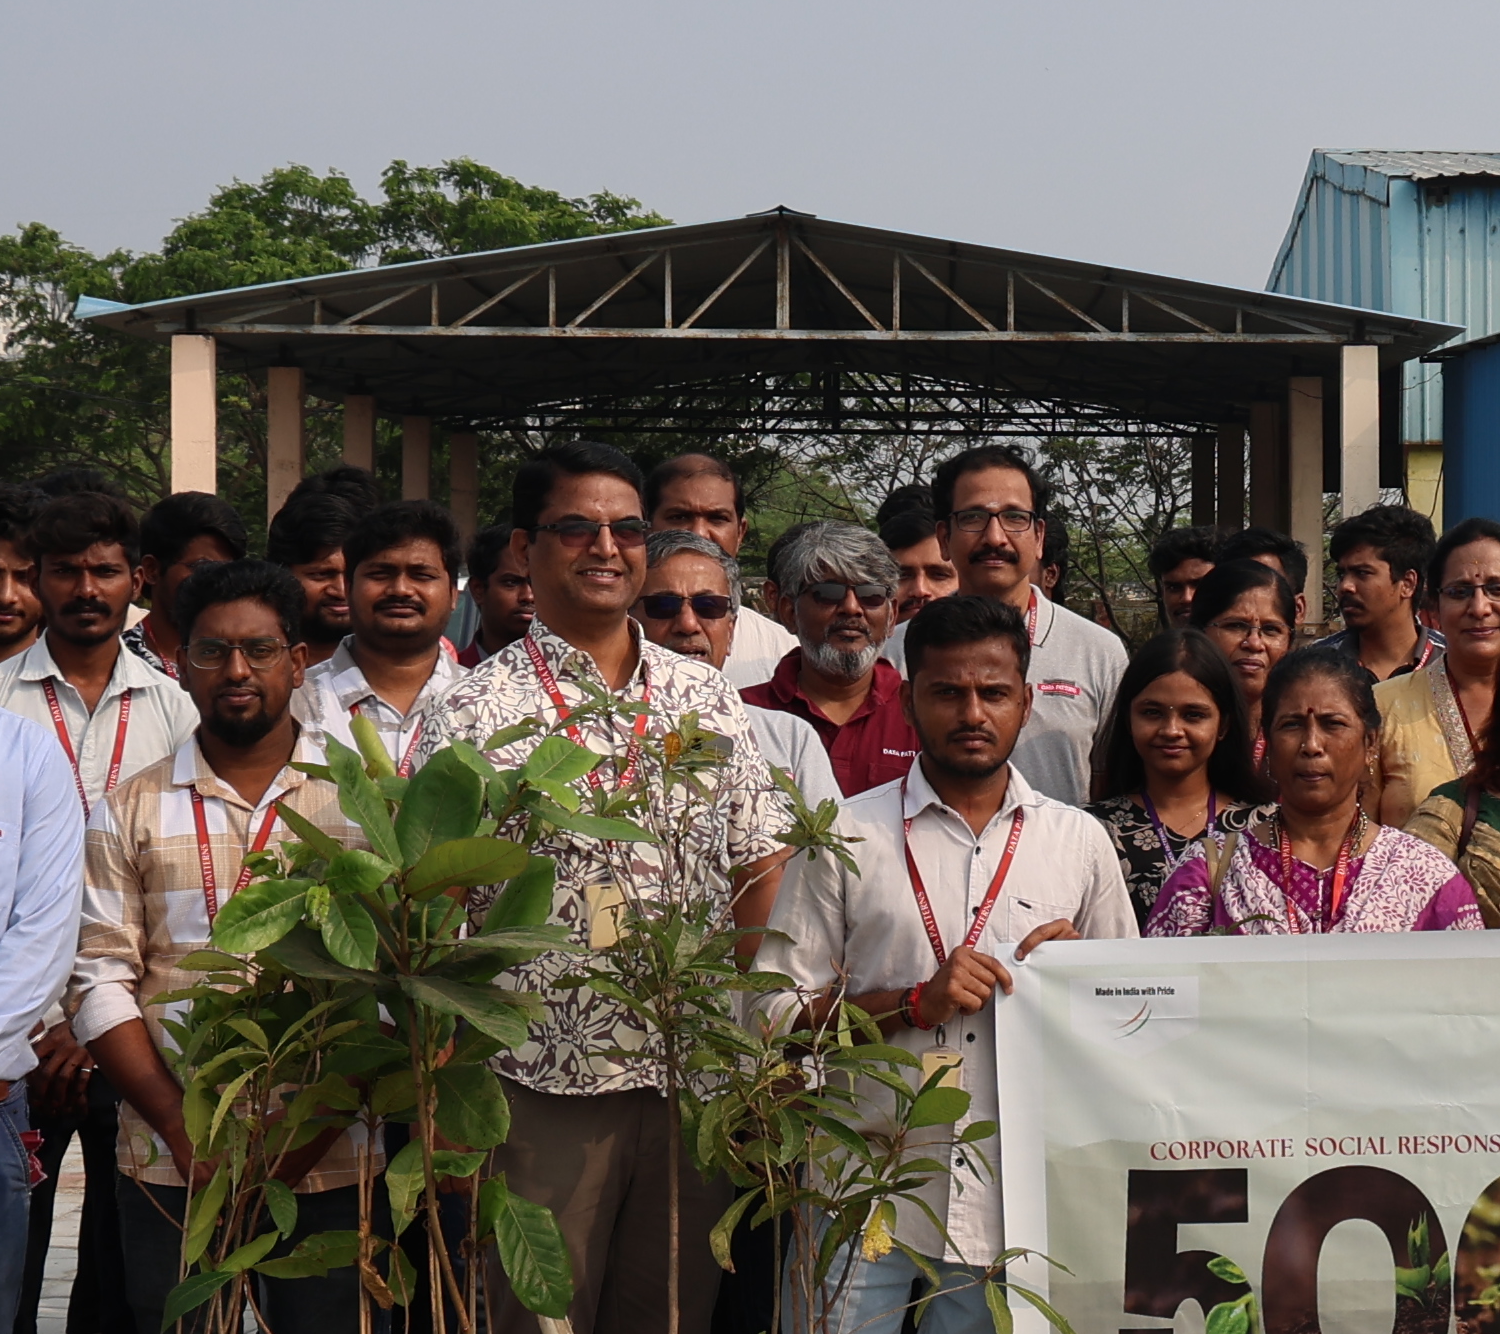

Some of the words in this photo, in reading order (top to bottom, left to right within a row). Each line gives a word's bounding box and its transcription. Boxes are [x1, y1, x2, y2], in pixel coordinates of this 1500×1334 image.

[542, 671, 558, 694] DATA
[50, 699, 63, 722] DATA
[120, 698, 131, 722] DATA
[883, 748, 900, 757] DATA
[900, 749, 917, 758] PATT
[1007, 830, 1021, 854] DATA
[200, 843, 214, 889] PATTERNS
[207, 890, 217, 915] DATA
[916, 891, 936, 938] PATTERNS
[969, 898, 995, 945] PATTERNS
[1095, 987, 1113, 996] Made
[1115, 987, 1122, 996] in
[1123, 987, 1140, 996] India
[1141, 987, 1156, 996] with
[1157, 986, 1175, 995] Pride
[1150, 1138, 1294, 1161] CORPORATE
[1304, 1135, 1392, 1157] SOCIAL
